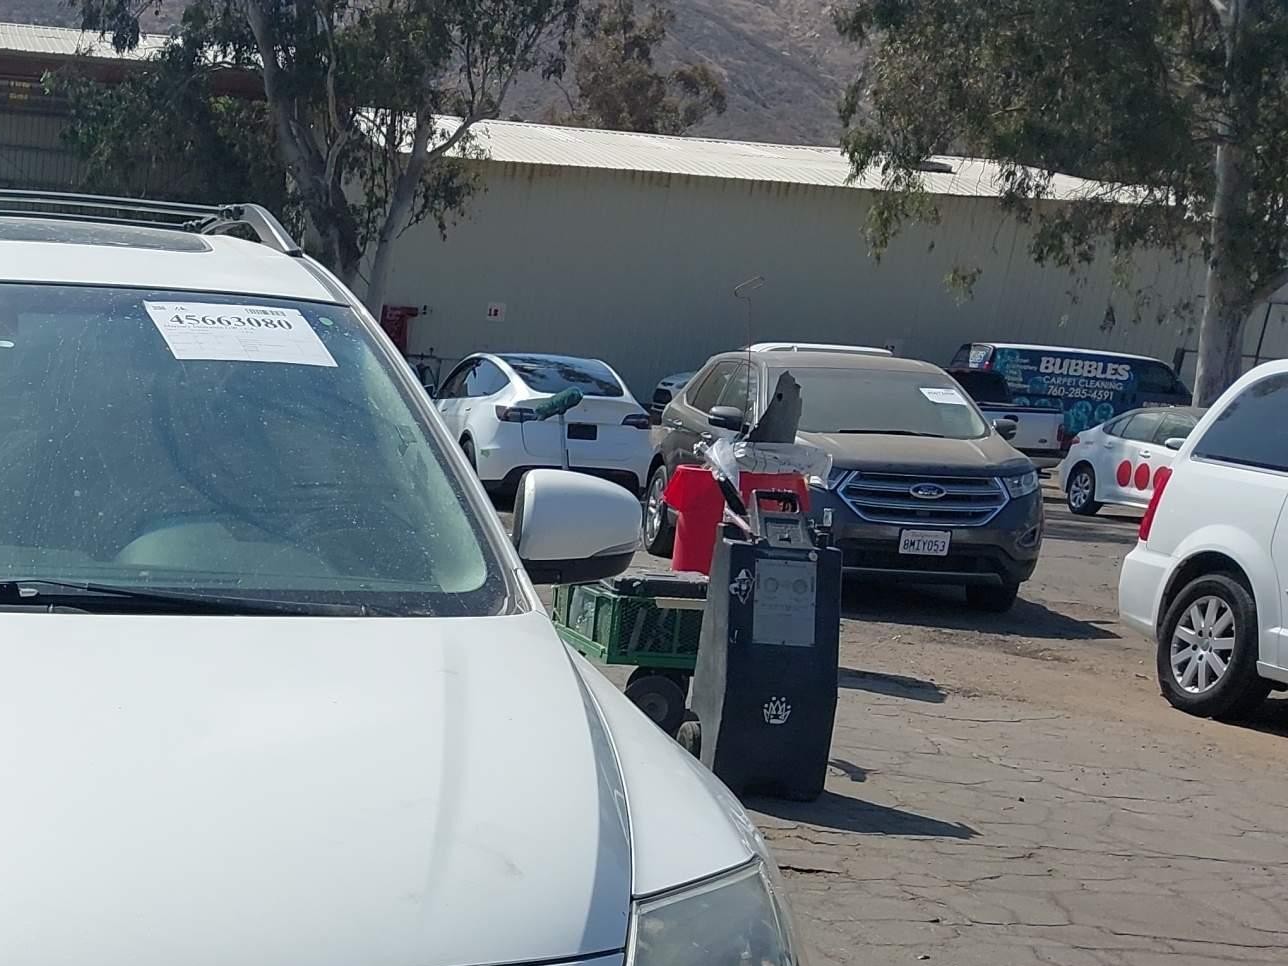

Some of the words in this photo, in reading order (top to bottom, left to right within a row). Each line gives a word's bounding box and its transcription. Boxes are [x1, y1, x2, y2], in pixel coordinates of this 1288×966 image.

[169, 313, 294, 330] 45663080
[1039, 356, 1131, 381] BUBBLES
[1043, 375, 1076, 387] CARPET
[1078, 378, 1124, 391] CLEANING
[1047, 384, 1114, 401] 760-285-4591
